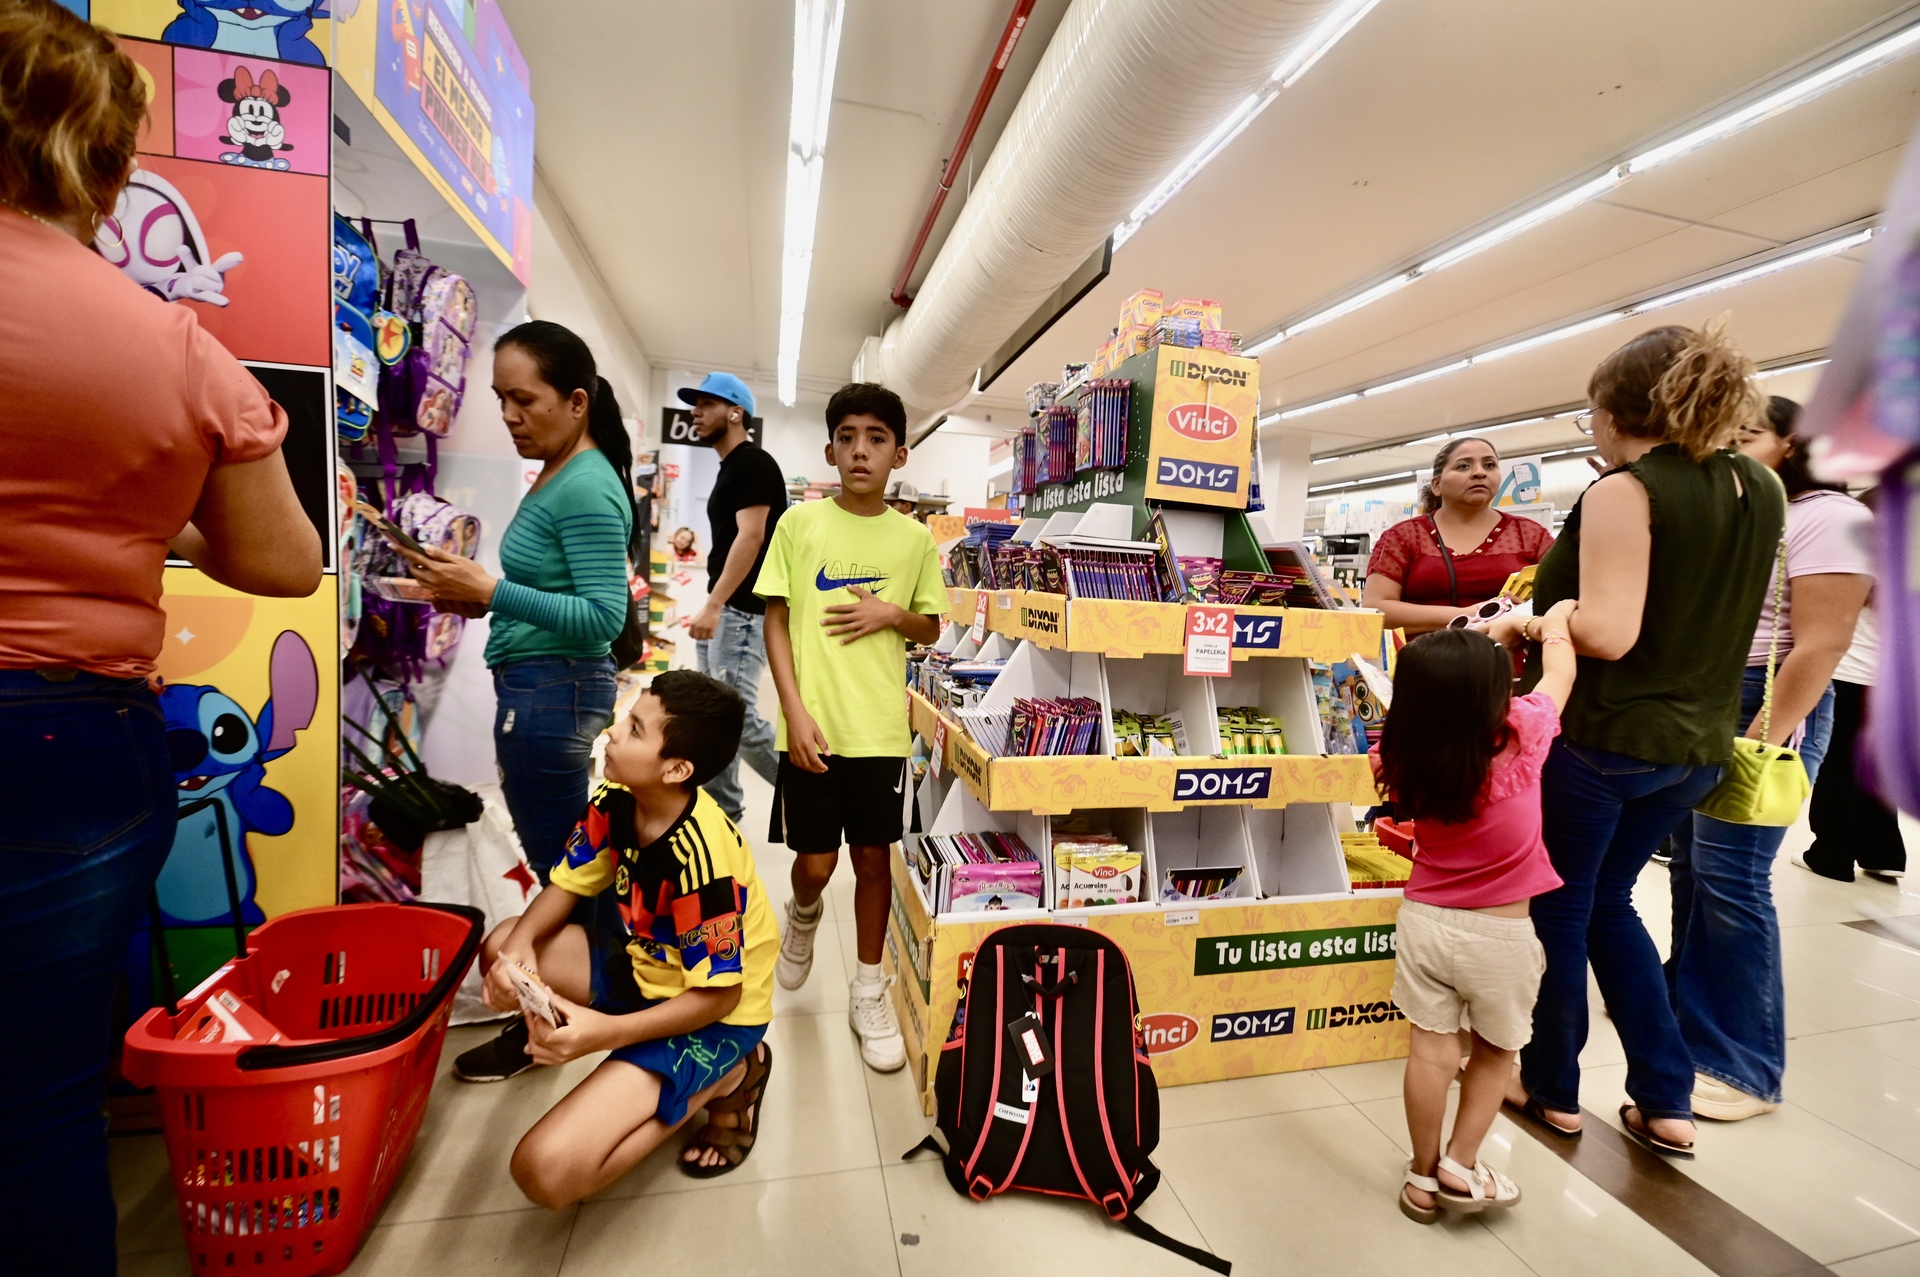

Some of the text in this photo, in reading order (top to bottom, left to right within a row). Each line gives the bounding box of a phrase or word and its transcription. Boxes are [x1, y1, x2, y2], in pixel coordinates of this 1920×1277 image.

[433, 53, 447, 96] EL
[449, 77, 483, 149] MEJOR
[425, 82, 468, 163] PRIMER
[1142, 298, 1161, 309] Gises
[1183, 308, 1204, 317] Gises
[1187, 363, 1247, 387] DIXON
[1175, 410, 1228, 436] Vinci
[1159, 461, 1234, 488] DOMS
[1043, 488, 1065, 511] lista
[1067, 480, 1091, 505] esta
[1094, 471, 1125, 499] lista
[826, 560, 881, 590] AIR
[1028, 608, 1058, 633] DIXON
[1192, 611, 1228, 634] 3x2
[1232, 619, 1276, 644] MS
[1195, 648, 1227, 656] PAPELERÍA
[960, 747, 982, 787] DIXON
[1177, 772, 1265, 796] DOMS
[1094, 868, 1115, 877] Vinci
[1074, 882, 1108, 890] Acuarelas
[1216, 941, 1242, 965] Tu
[1250, 939, 1301, 963] lista
[1309, 935, 1356, 959] esta
[1144, 1019, 1189, 1046] inci
[1214, 1011, 1290, 1039] DOMS
[998, 1107, 1025, 1119] CHENSON
